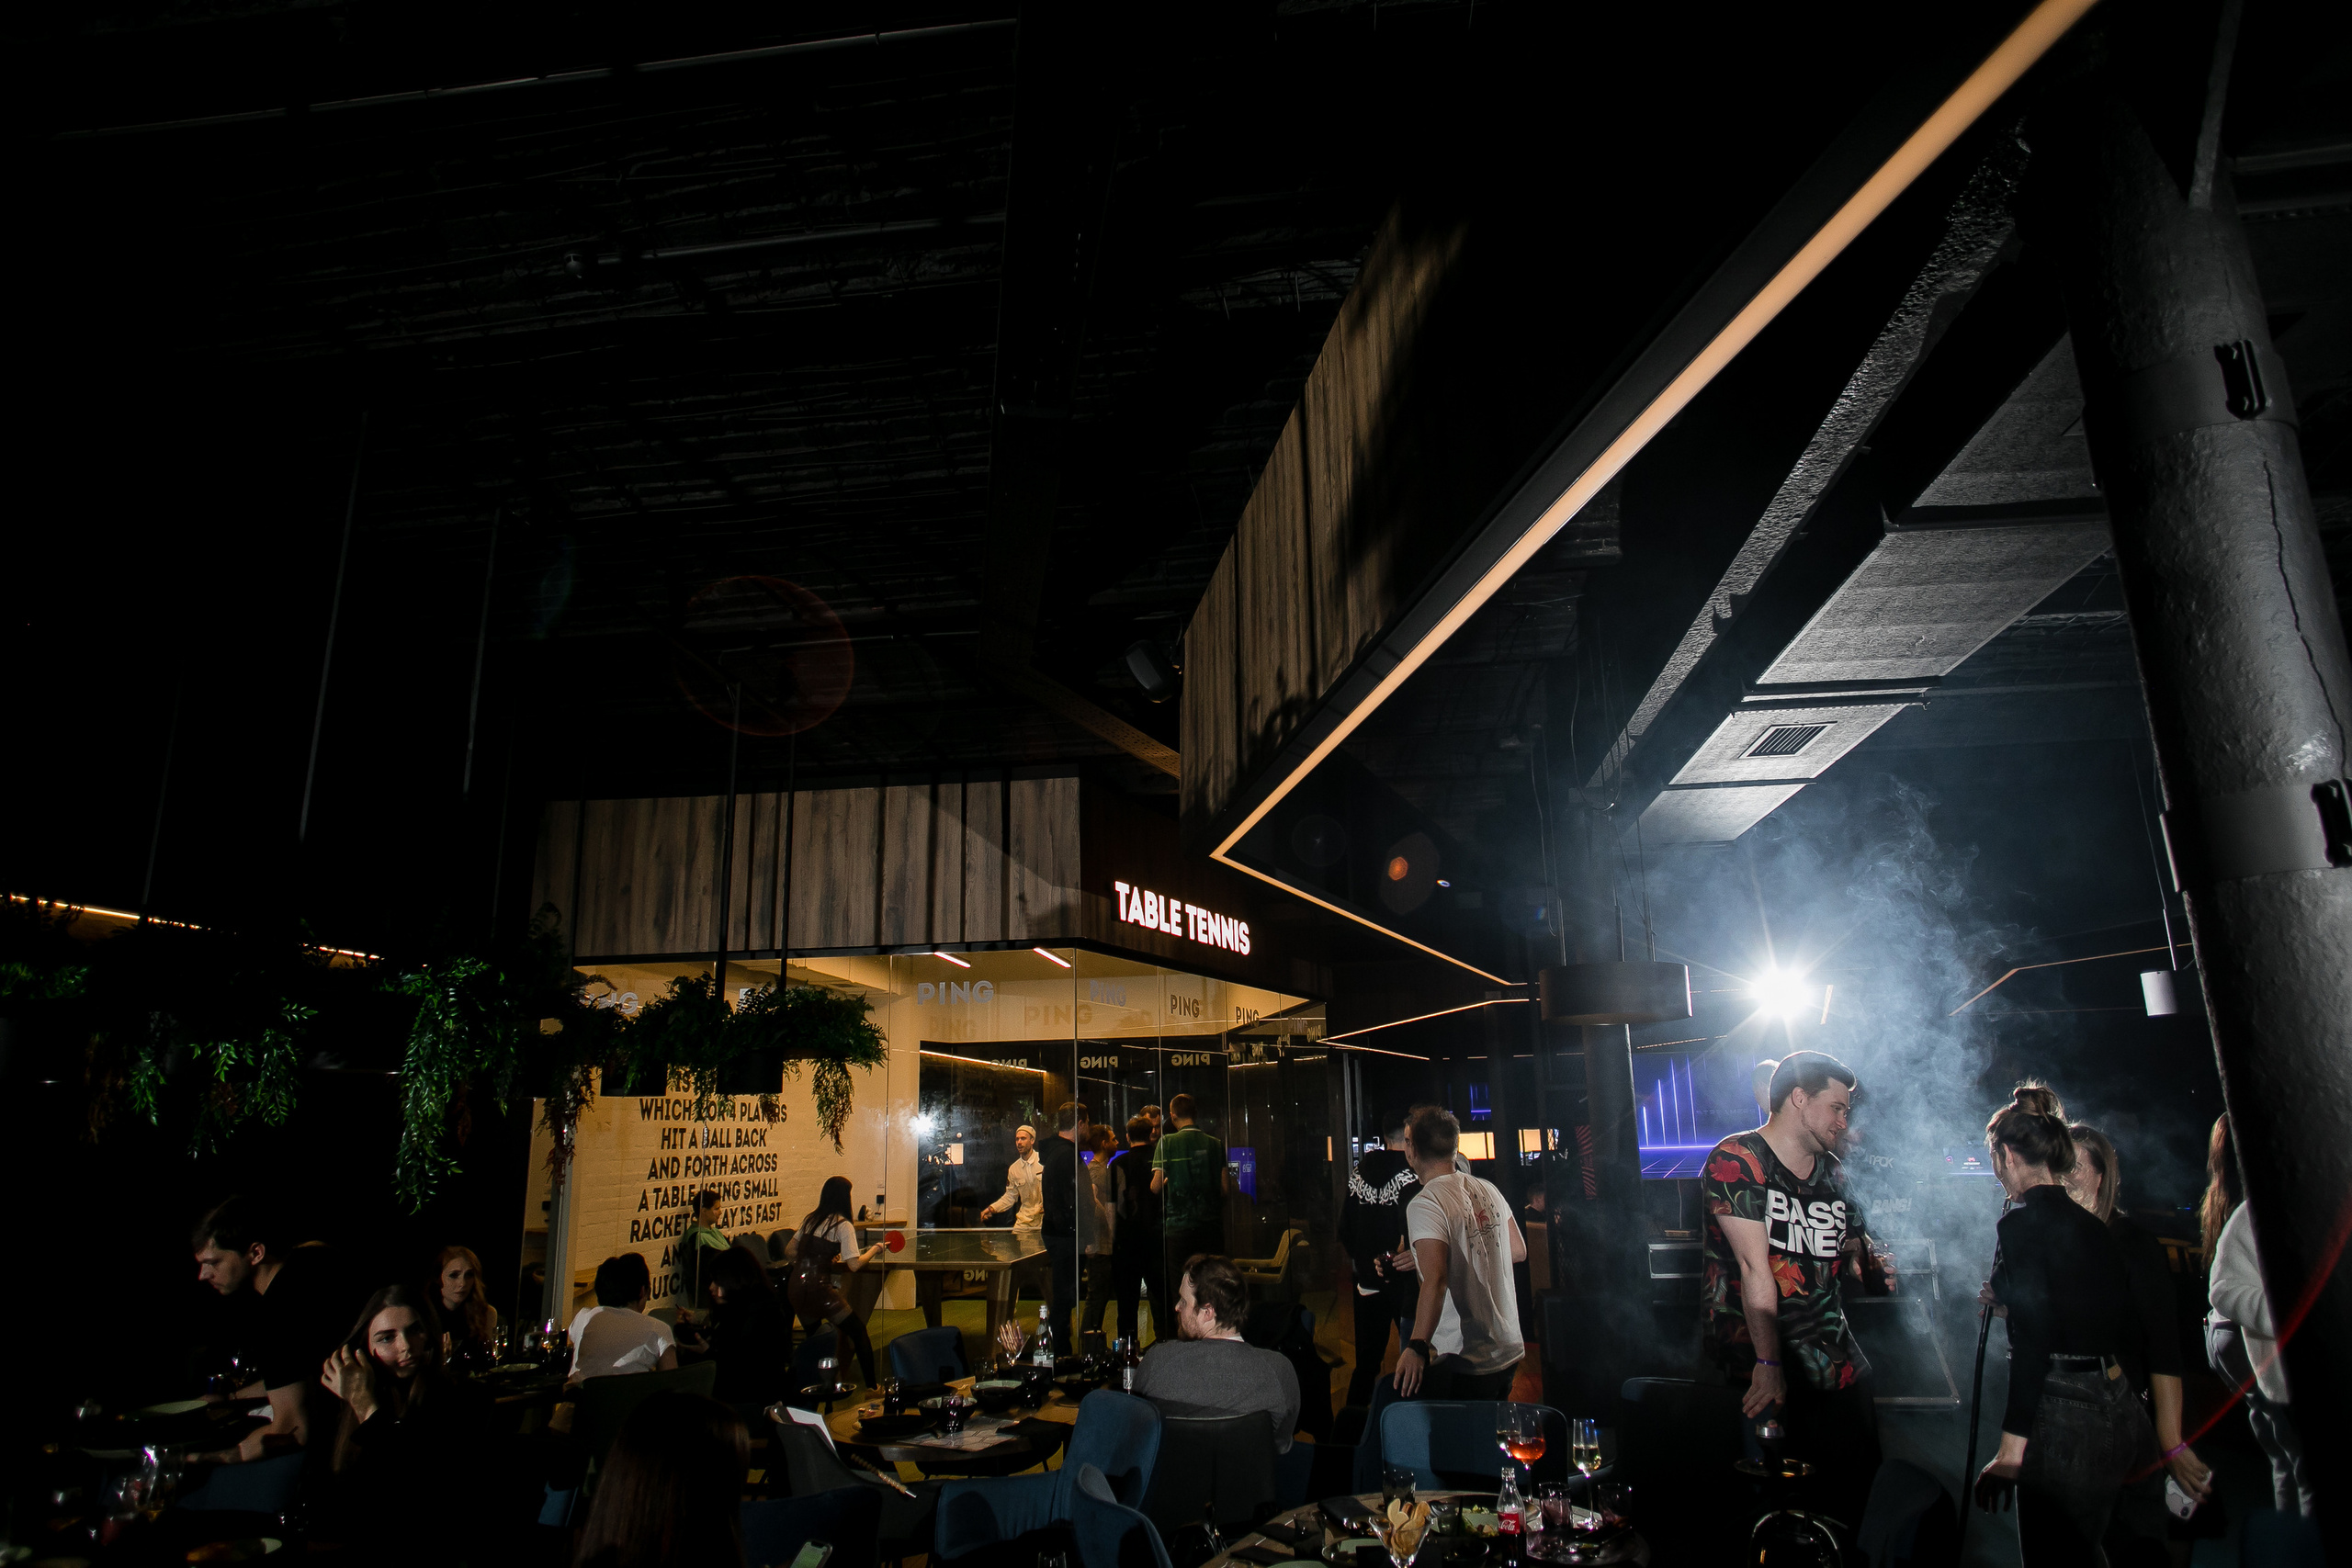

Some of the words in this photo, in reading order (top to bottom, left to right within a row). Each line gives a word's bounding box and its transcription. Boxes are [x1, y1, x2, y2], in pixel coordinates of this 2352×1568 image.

[1114, 880, 1182, 937] TABLE
[1184, 903, 1250, 955] TENNIS
[917, 980, 994, 1006] PING
[1090, 979, 1127, 1007] PING
[1170, 993, 1200, 1019] PING
[1235, 1006, 1260, 1028] PING
[639, 1098, 692, 1122] WHICH
[661, 1127, 686, 1150] HIT
[688, 1128, 698, 1149] A
[734, 1127, 768, 1148] BACK
[647, 1156, 681, 1180] AND
[684, 1155, 729, 1178] FORTH
[730, 1153, 778, 1175] ACROSS
[637, 1189, 650, 1213] A
[653, 1184, 695, 1211] TABLE
[743, 1178, 779, 1201] SMALL
[1871, 1197, 1913, 1215] BANG!
[740, 1205, 752, 1227] IS
[755, 1201, 783, 1224] FAST
[1765, 1189, 1847, 1230] BASS
[660, 1245, 684, 1269] AN
